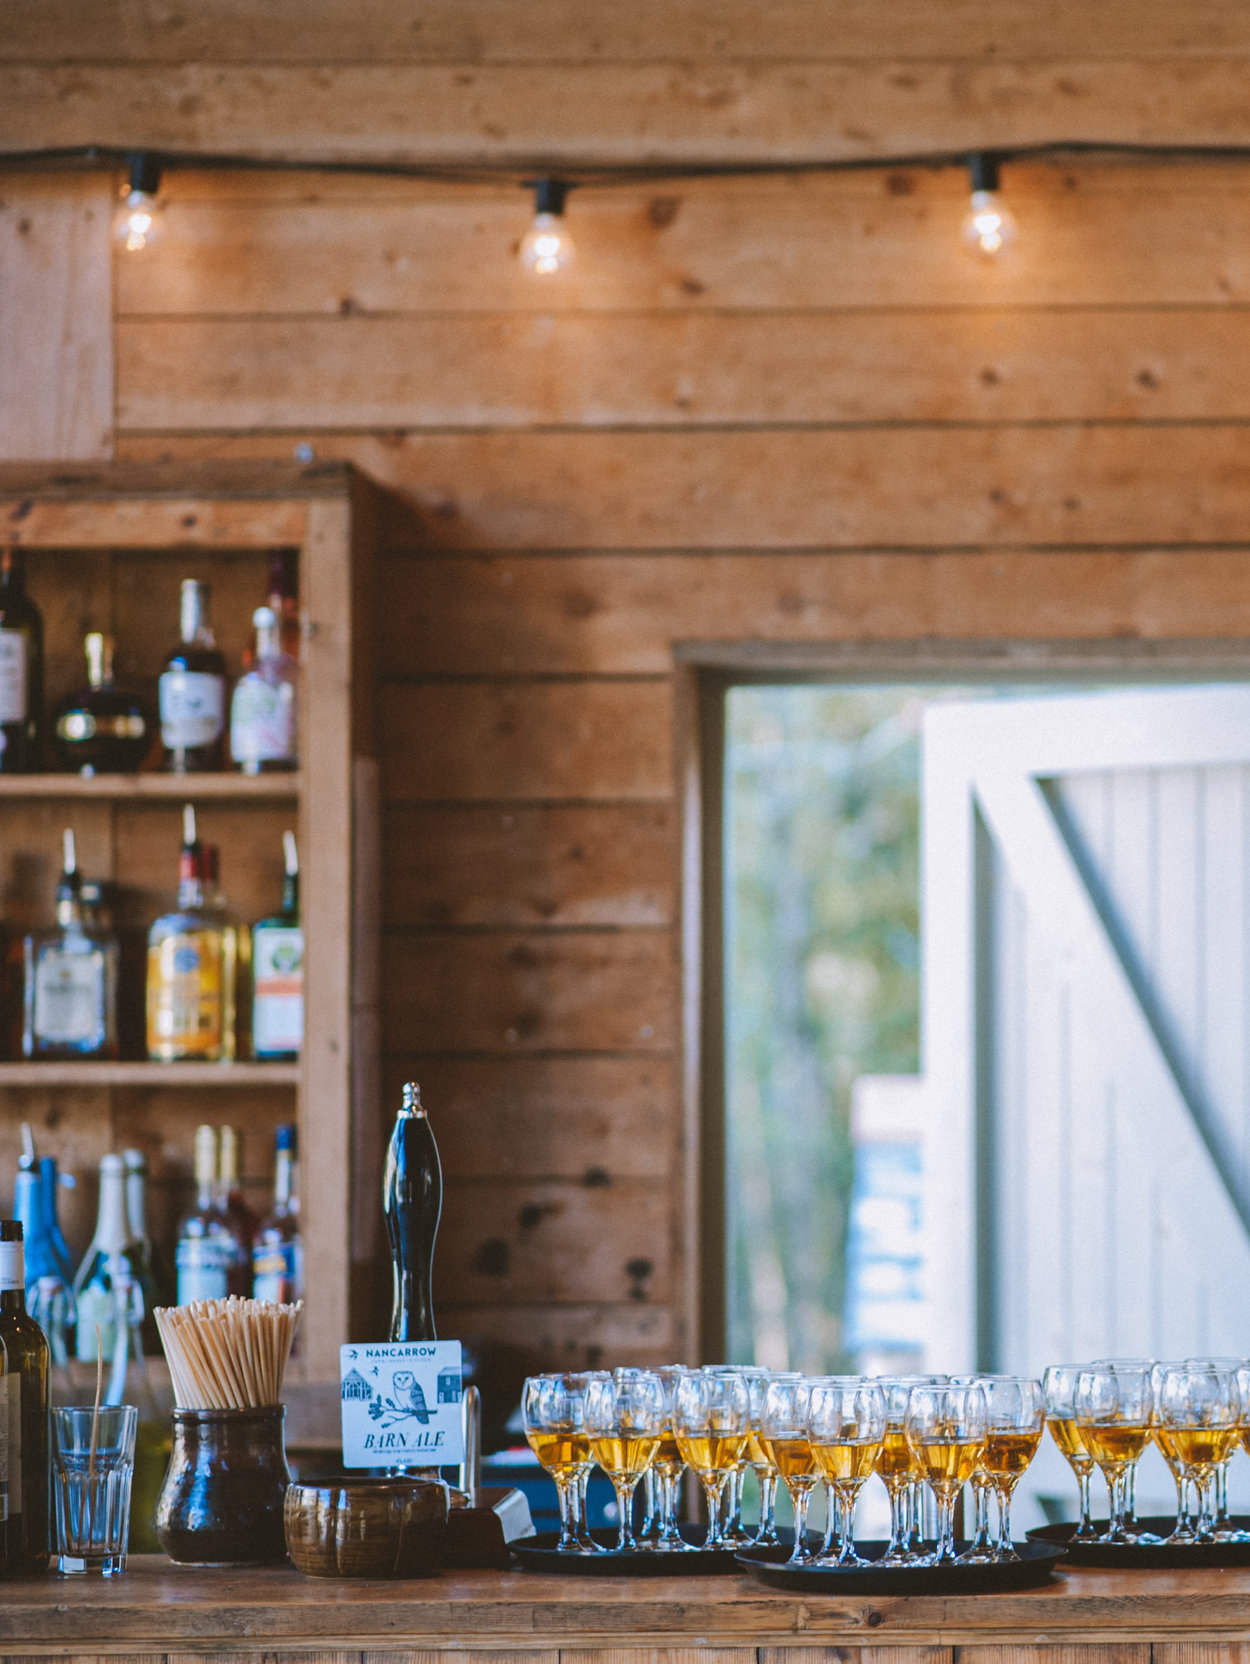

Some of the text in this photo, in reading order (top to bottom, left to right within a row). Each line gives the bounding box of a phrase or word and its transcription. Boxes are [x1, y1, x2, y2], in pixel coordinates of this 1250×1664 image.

[366, 1347, 436, 1358] NANCARROW
[364, 1430, 446, 1449] BARN ALE
